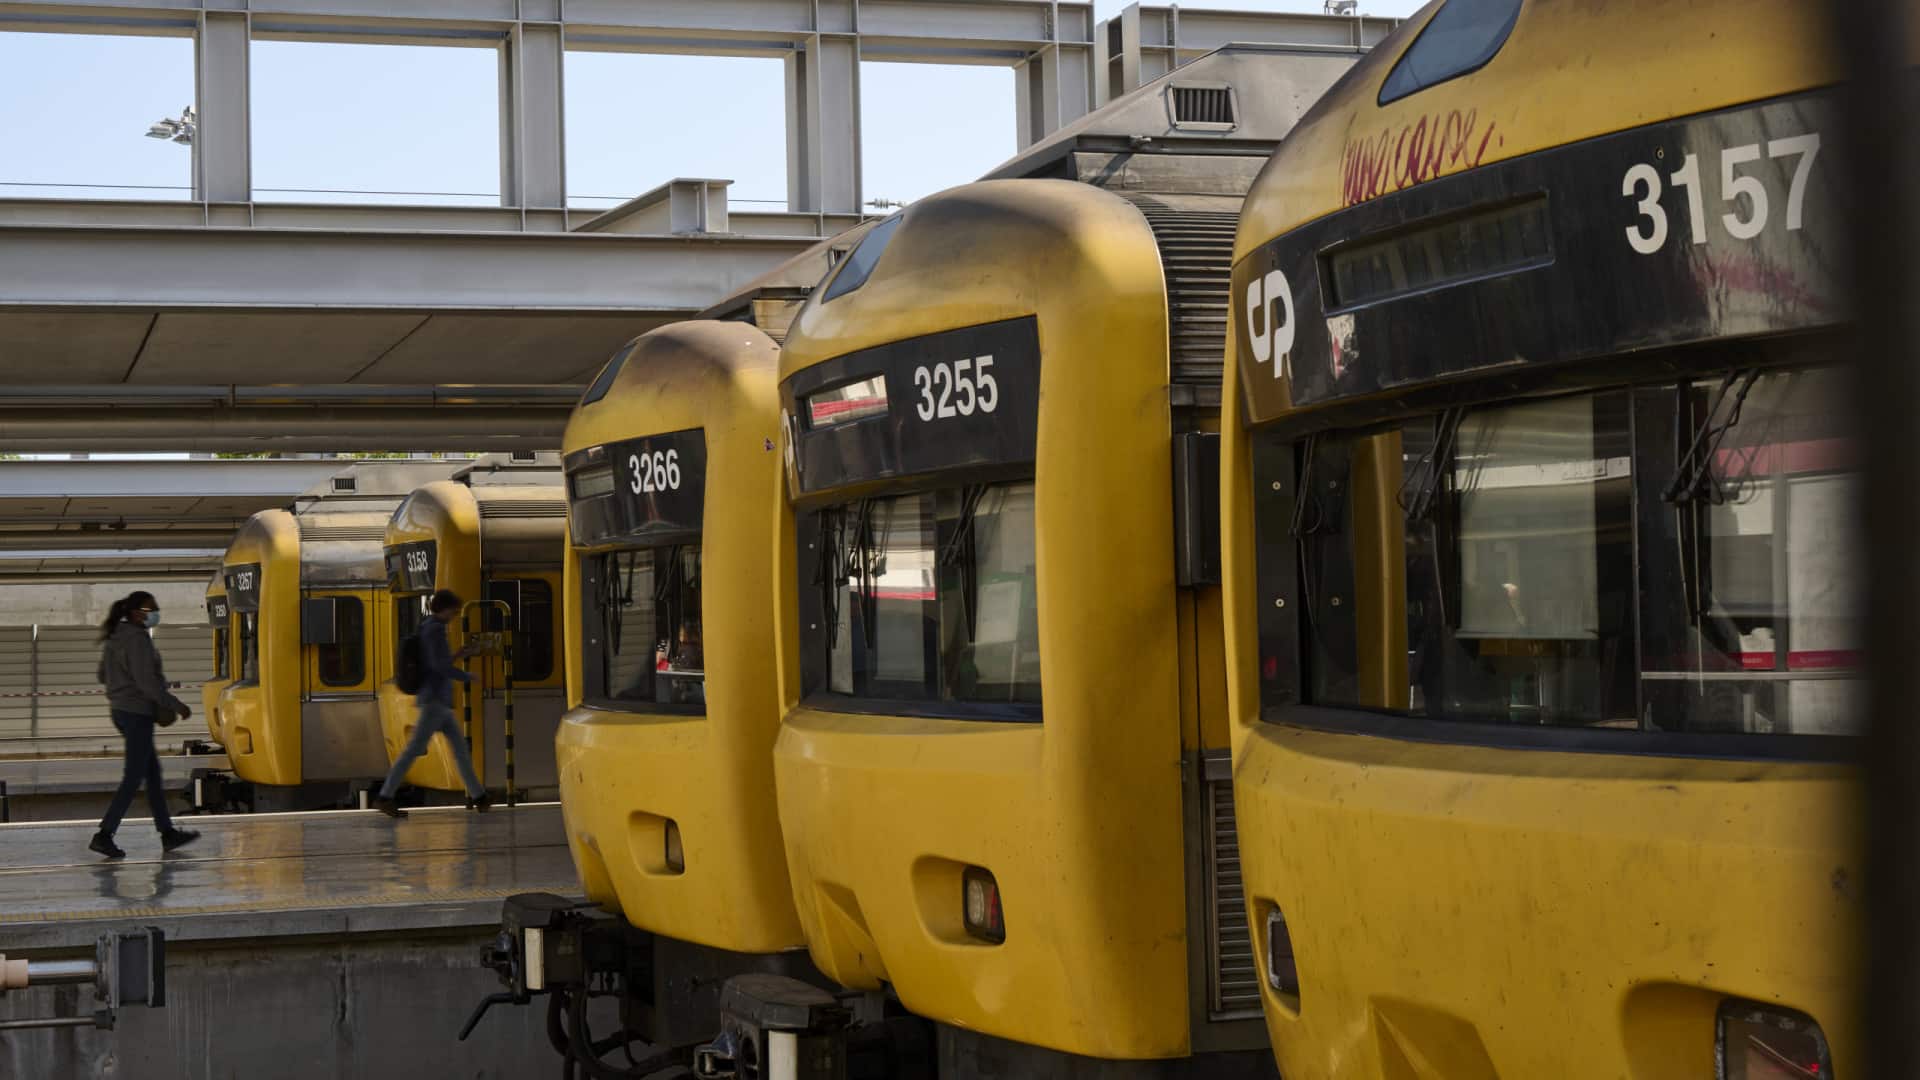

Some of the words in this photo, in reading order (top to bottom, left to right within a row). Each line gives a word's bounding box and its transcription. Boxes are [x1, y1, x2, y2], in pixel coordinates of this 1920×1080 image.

[1622, 133, 1820, 254] 3157
[914, 354, 998, 422] 3255
[629, 448, 681, 495] 3266
[237, 571, 253, 591] 3267
[406, 550, 429, 572] 3158
